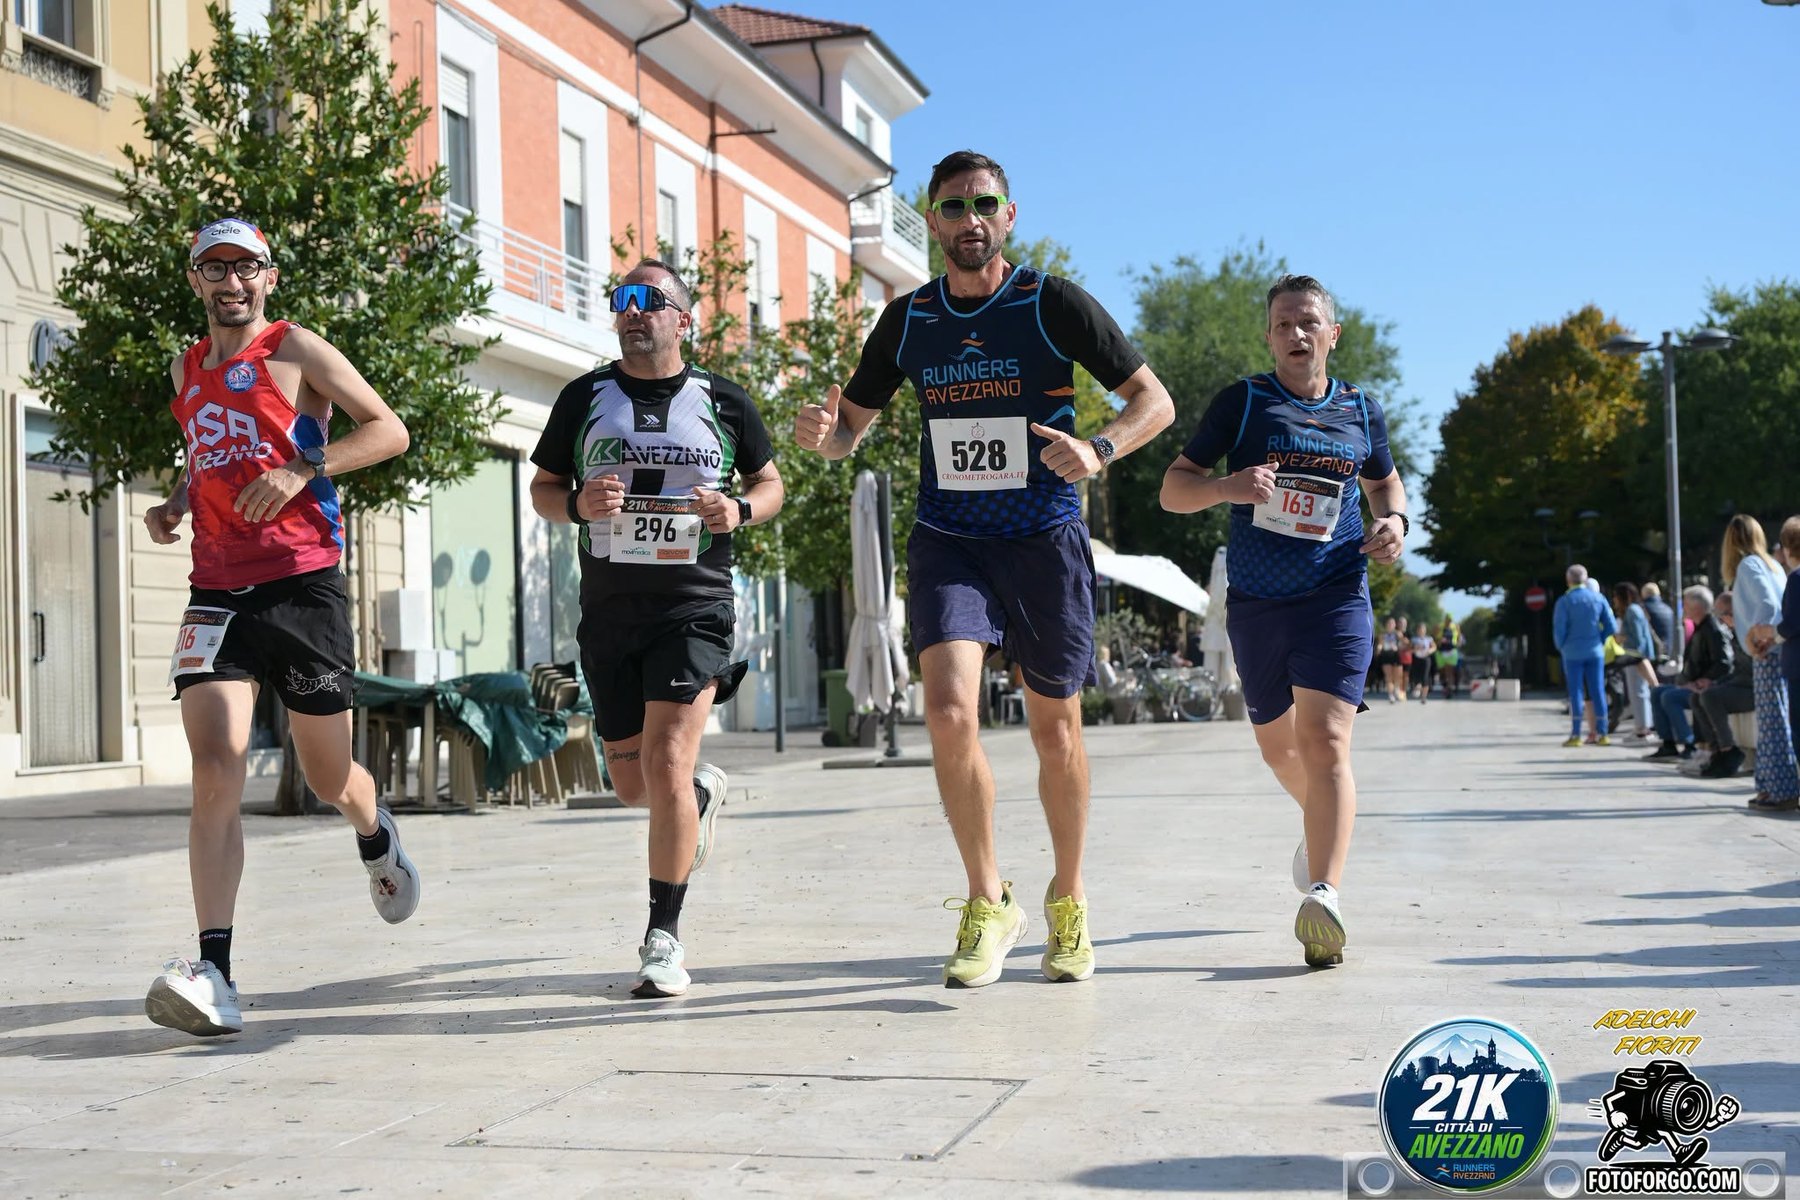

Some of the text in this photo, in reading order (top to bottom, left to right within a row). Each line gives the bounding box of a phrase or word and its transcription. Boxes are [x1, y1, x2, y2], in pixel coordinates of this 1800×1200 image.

[923, 359, 1020, 387] RUNNERS
[925, 379, 1022, 406] AVEZZANO
[621, 438, 720, 469] AVEZZANO
[951, 439, 1007, 473] 528
[1267, 435, 1355, 460] RUNNERS
[942, 471, 1025, 481] CRONOMETROGARA.IT
[1267, 452, 1355, 476] AVEZZANO
[627, 500, 649, 511] 21K
[1282, 491, 1315, 517] 163
[634, 516, 677, 542] 296
